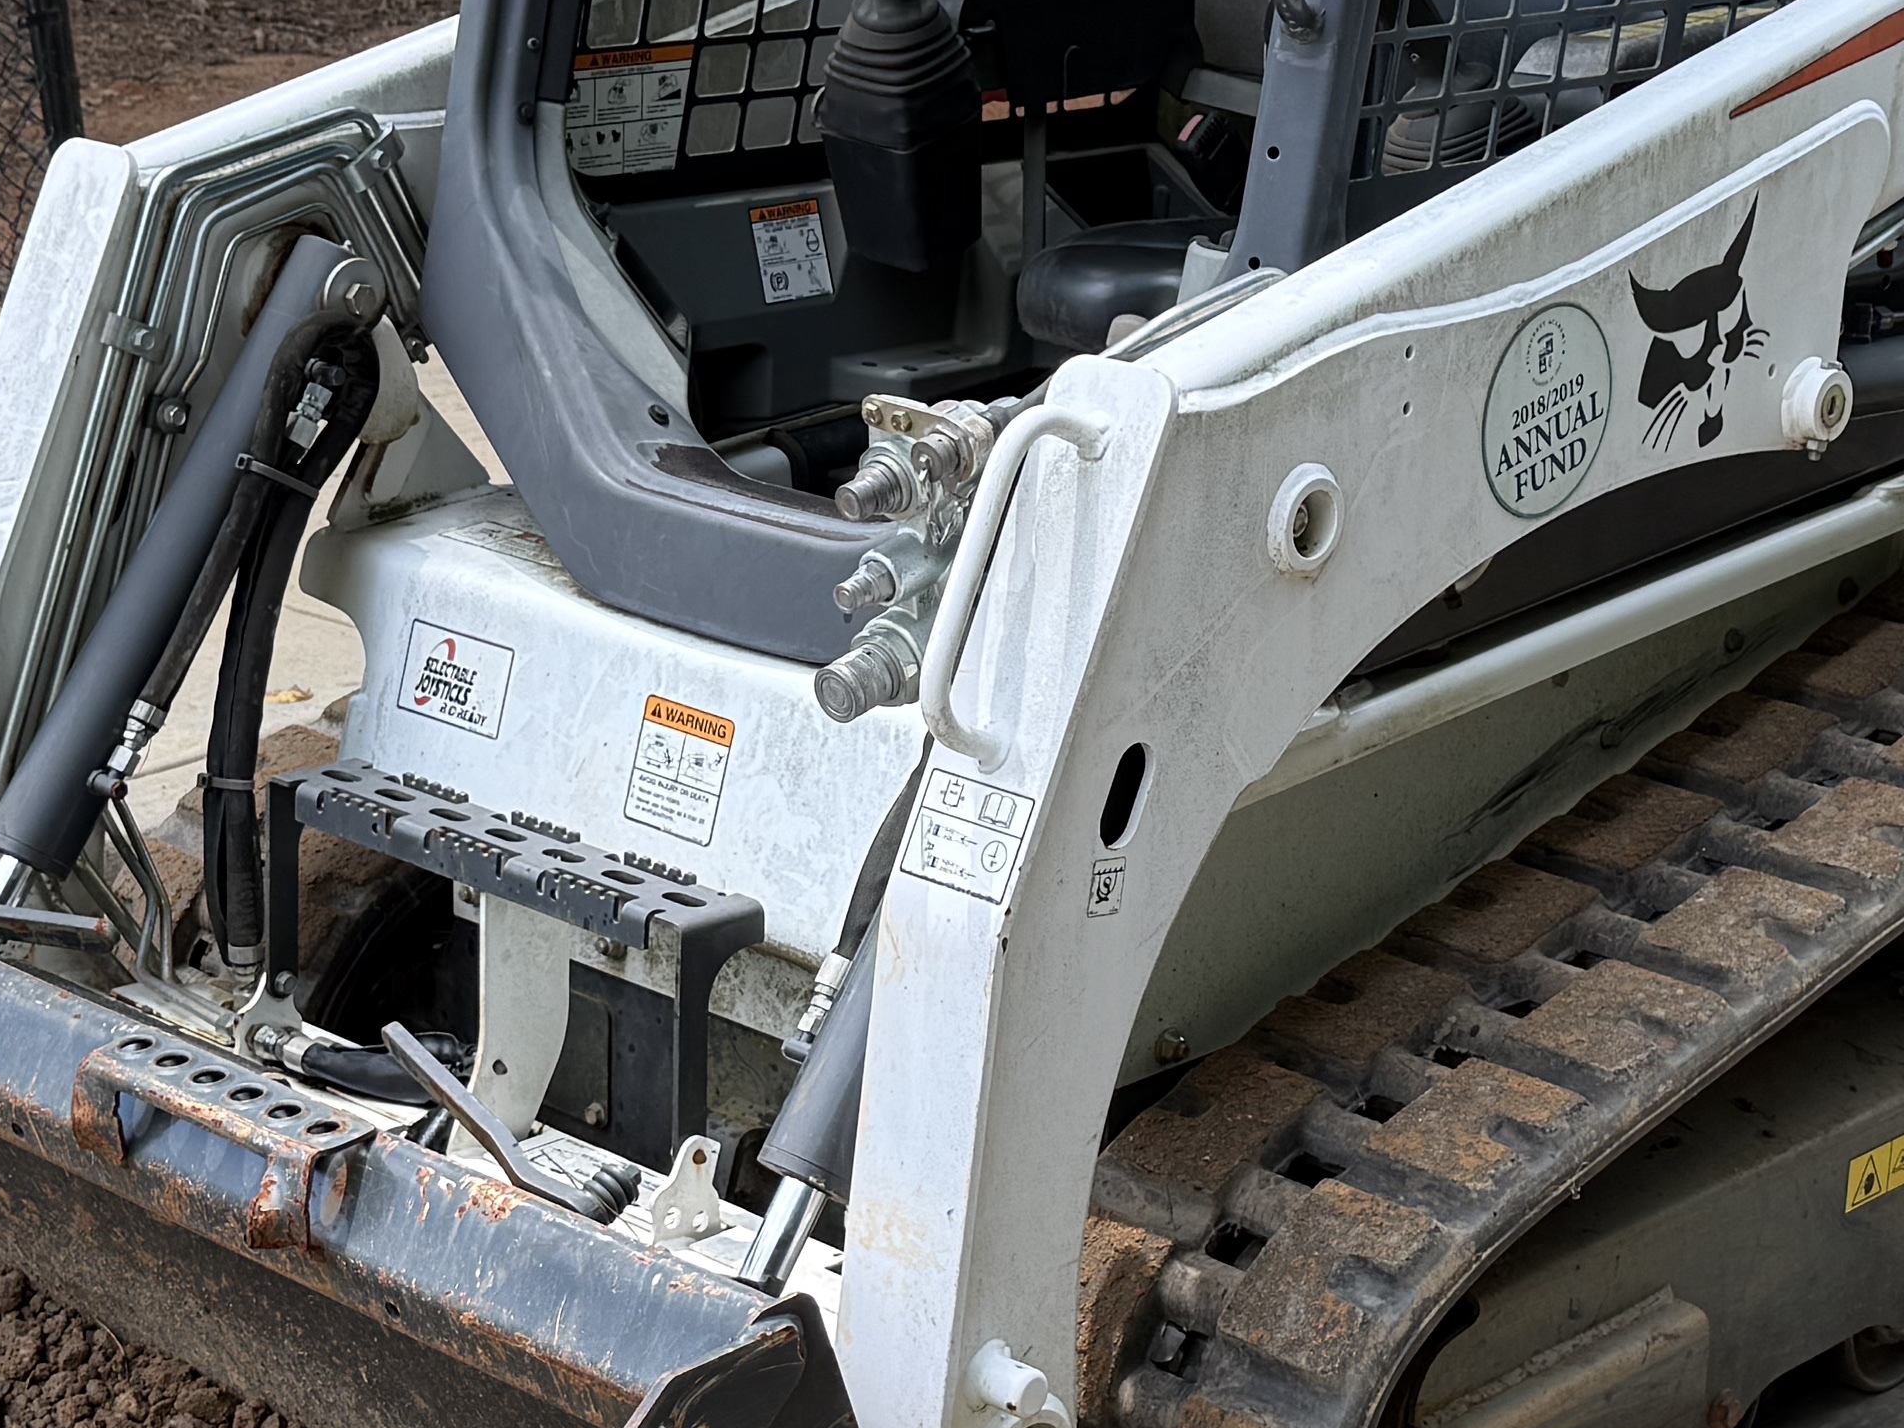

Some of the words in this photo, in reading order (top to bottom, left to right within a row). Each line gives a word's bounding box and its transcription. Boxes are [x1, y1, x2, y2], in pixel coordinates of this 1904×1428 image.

[601, 50, 653, 66] WARNING
[767, 202, 813, 219] WARNING
[1511, 373, 1585, 431] 2018/2019
[1495, 391, 1604, 478] ANNUAL
[1514, 437, 1587, 503] FUND
[423, 656, 478, 687] SELECTABLE
[414, 672, 472, 707] JOYSTICKS
[665, 706, 728, 739] WARNING
